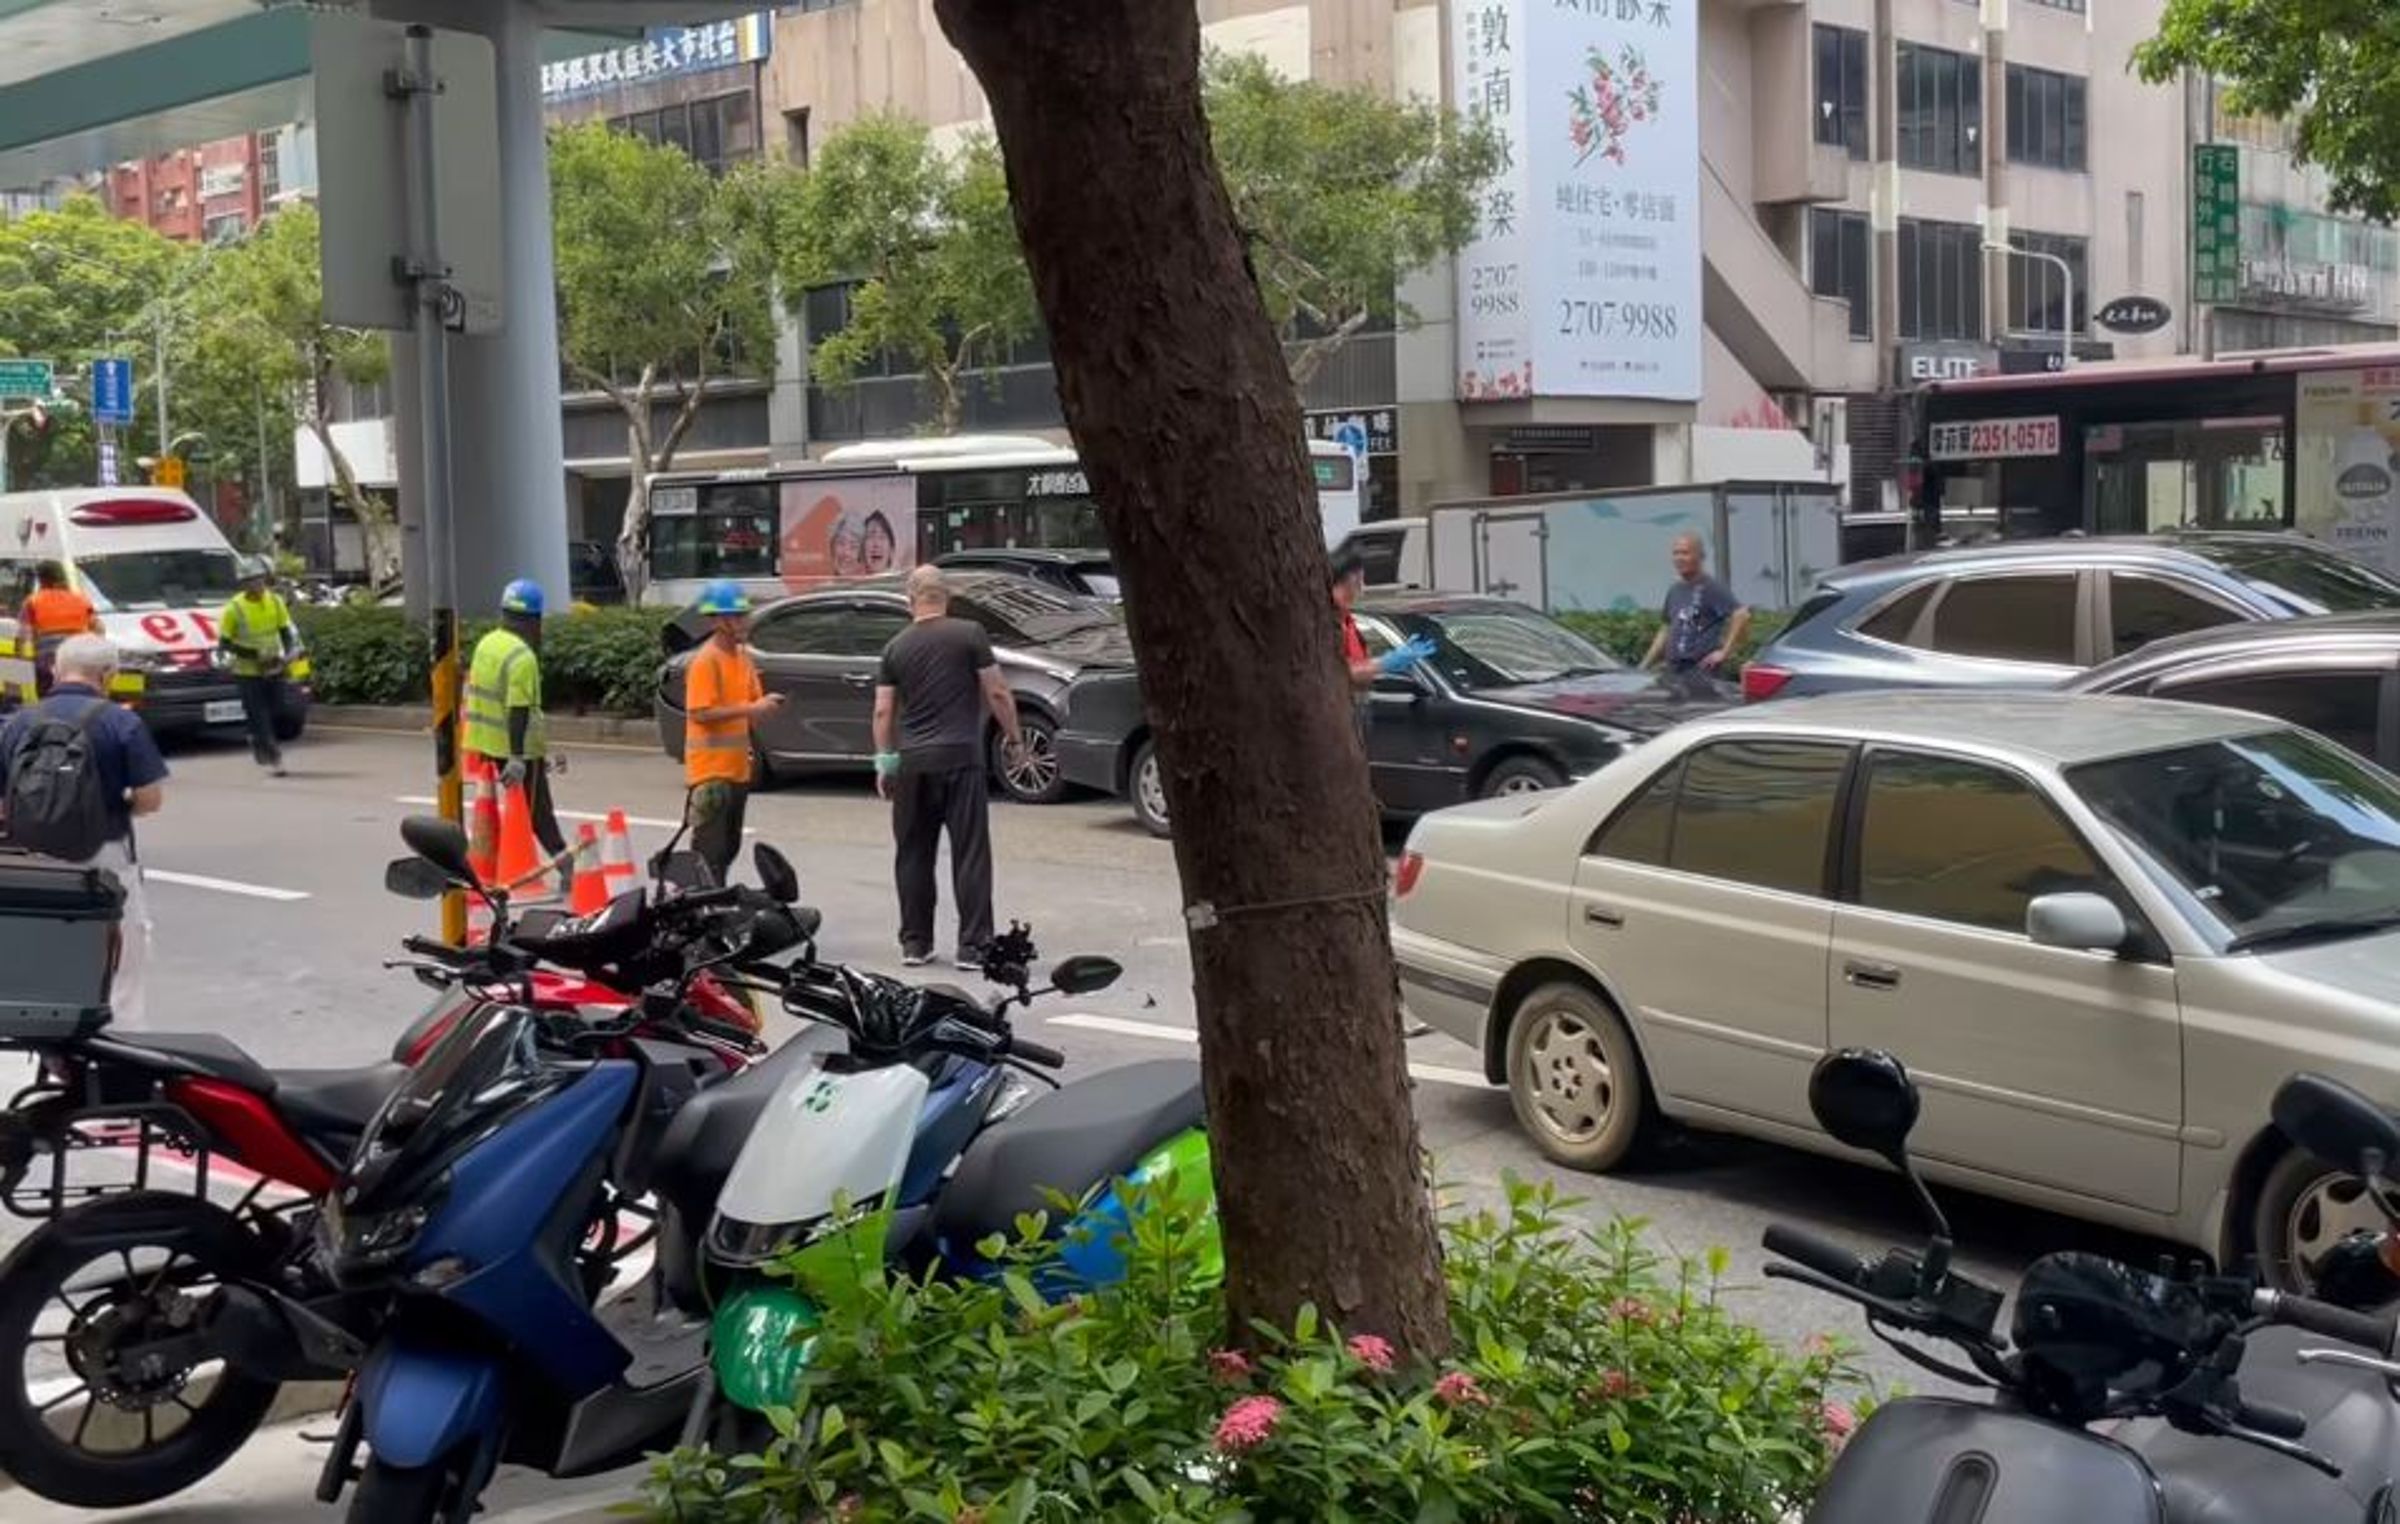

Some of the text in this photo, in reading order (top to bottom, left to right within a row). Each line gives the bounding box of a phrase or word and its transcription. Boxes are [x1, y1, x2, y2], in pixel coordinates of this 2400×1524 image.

[1471, 264, 1518, 290] 2707
[1471, 292, 1520, 316] 9988
[1972, 422, 2056, 453] 2351-0578
